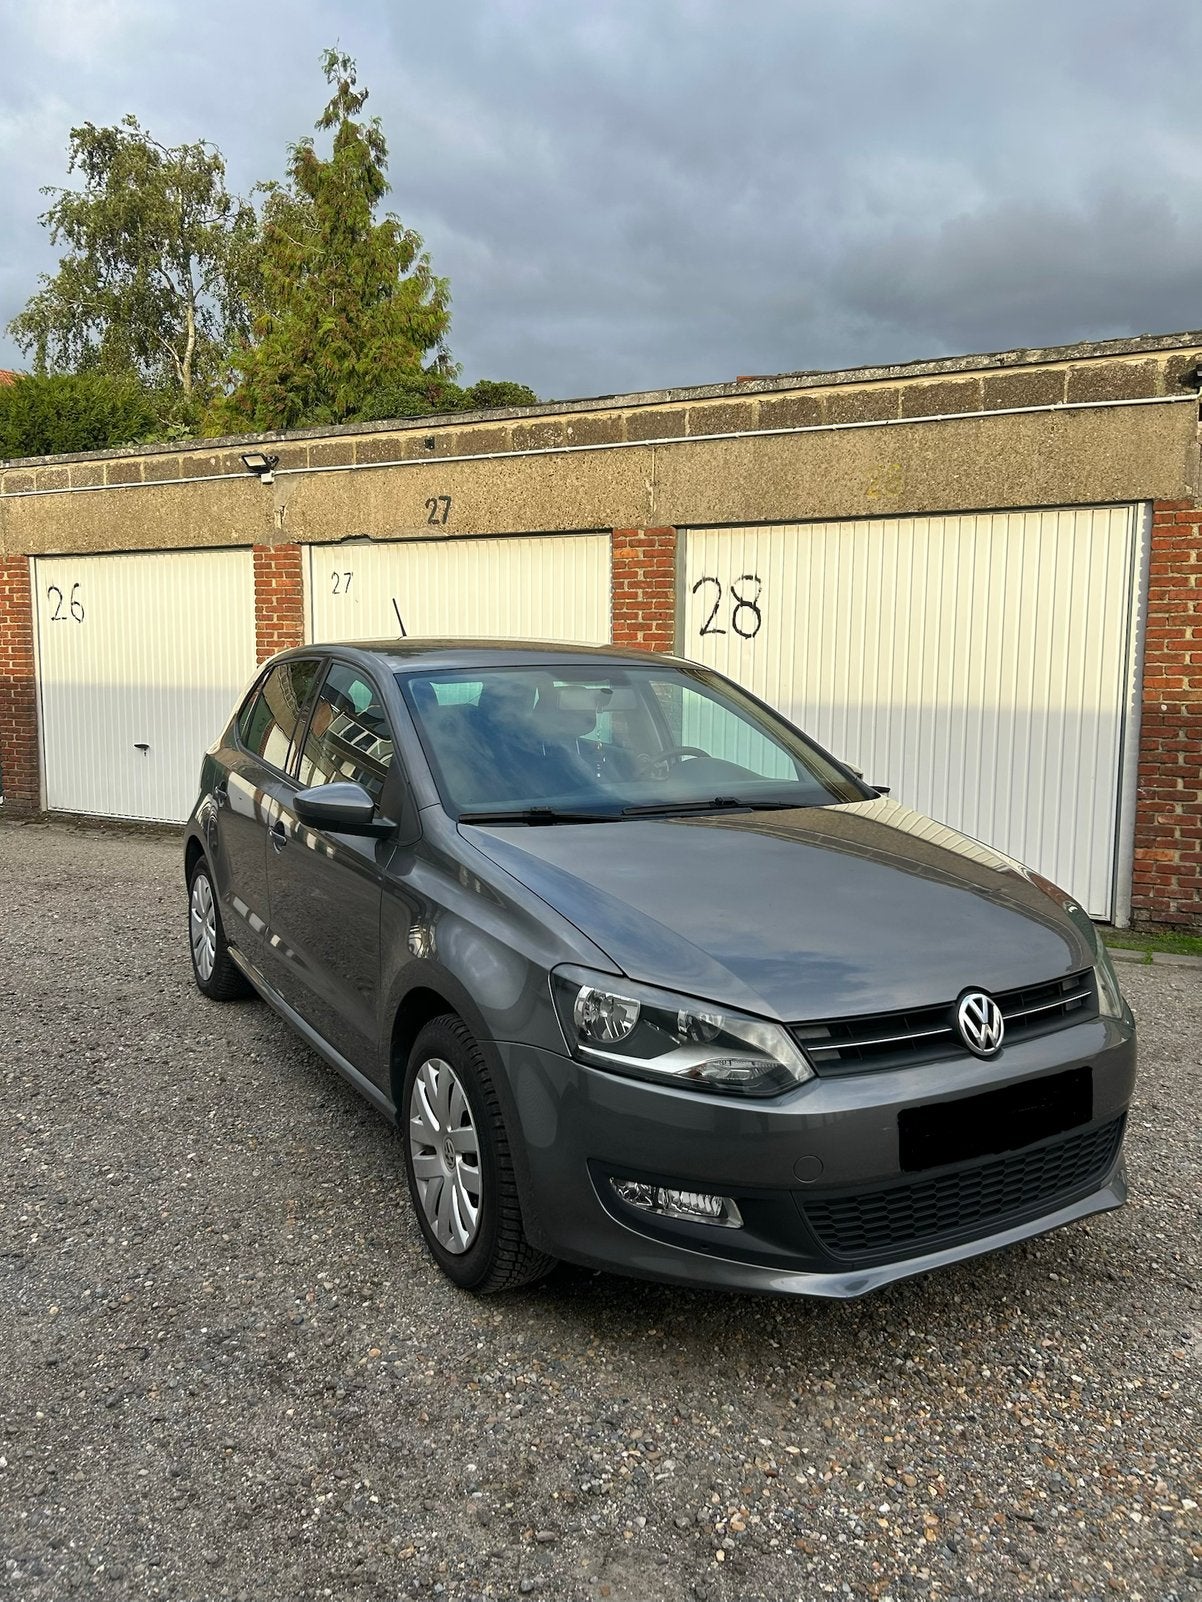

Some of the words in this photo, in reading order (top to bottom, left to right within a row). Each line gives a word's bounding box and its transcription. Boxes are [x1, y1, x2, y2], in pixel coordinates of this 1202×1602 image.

[424, 494, 452, 525] 27
[47, 582, 84, 623] 26
[330, 571, 353, 596] 27
[692, 575, 763, 639] 28
[958, 993, 1004, 1056] VW
